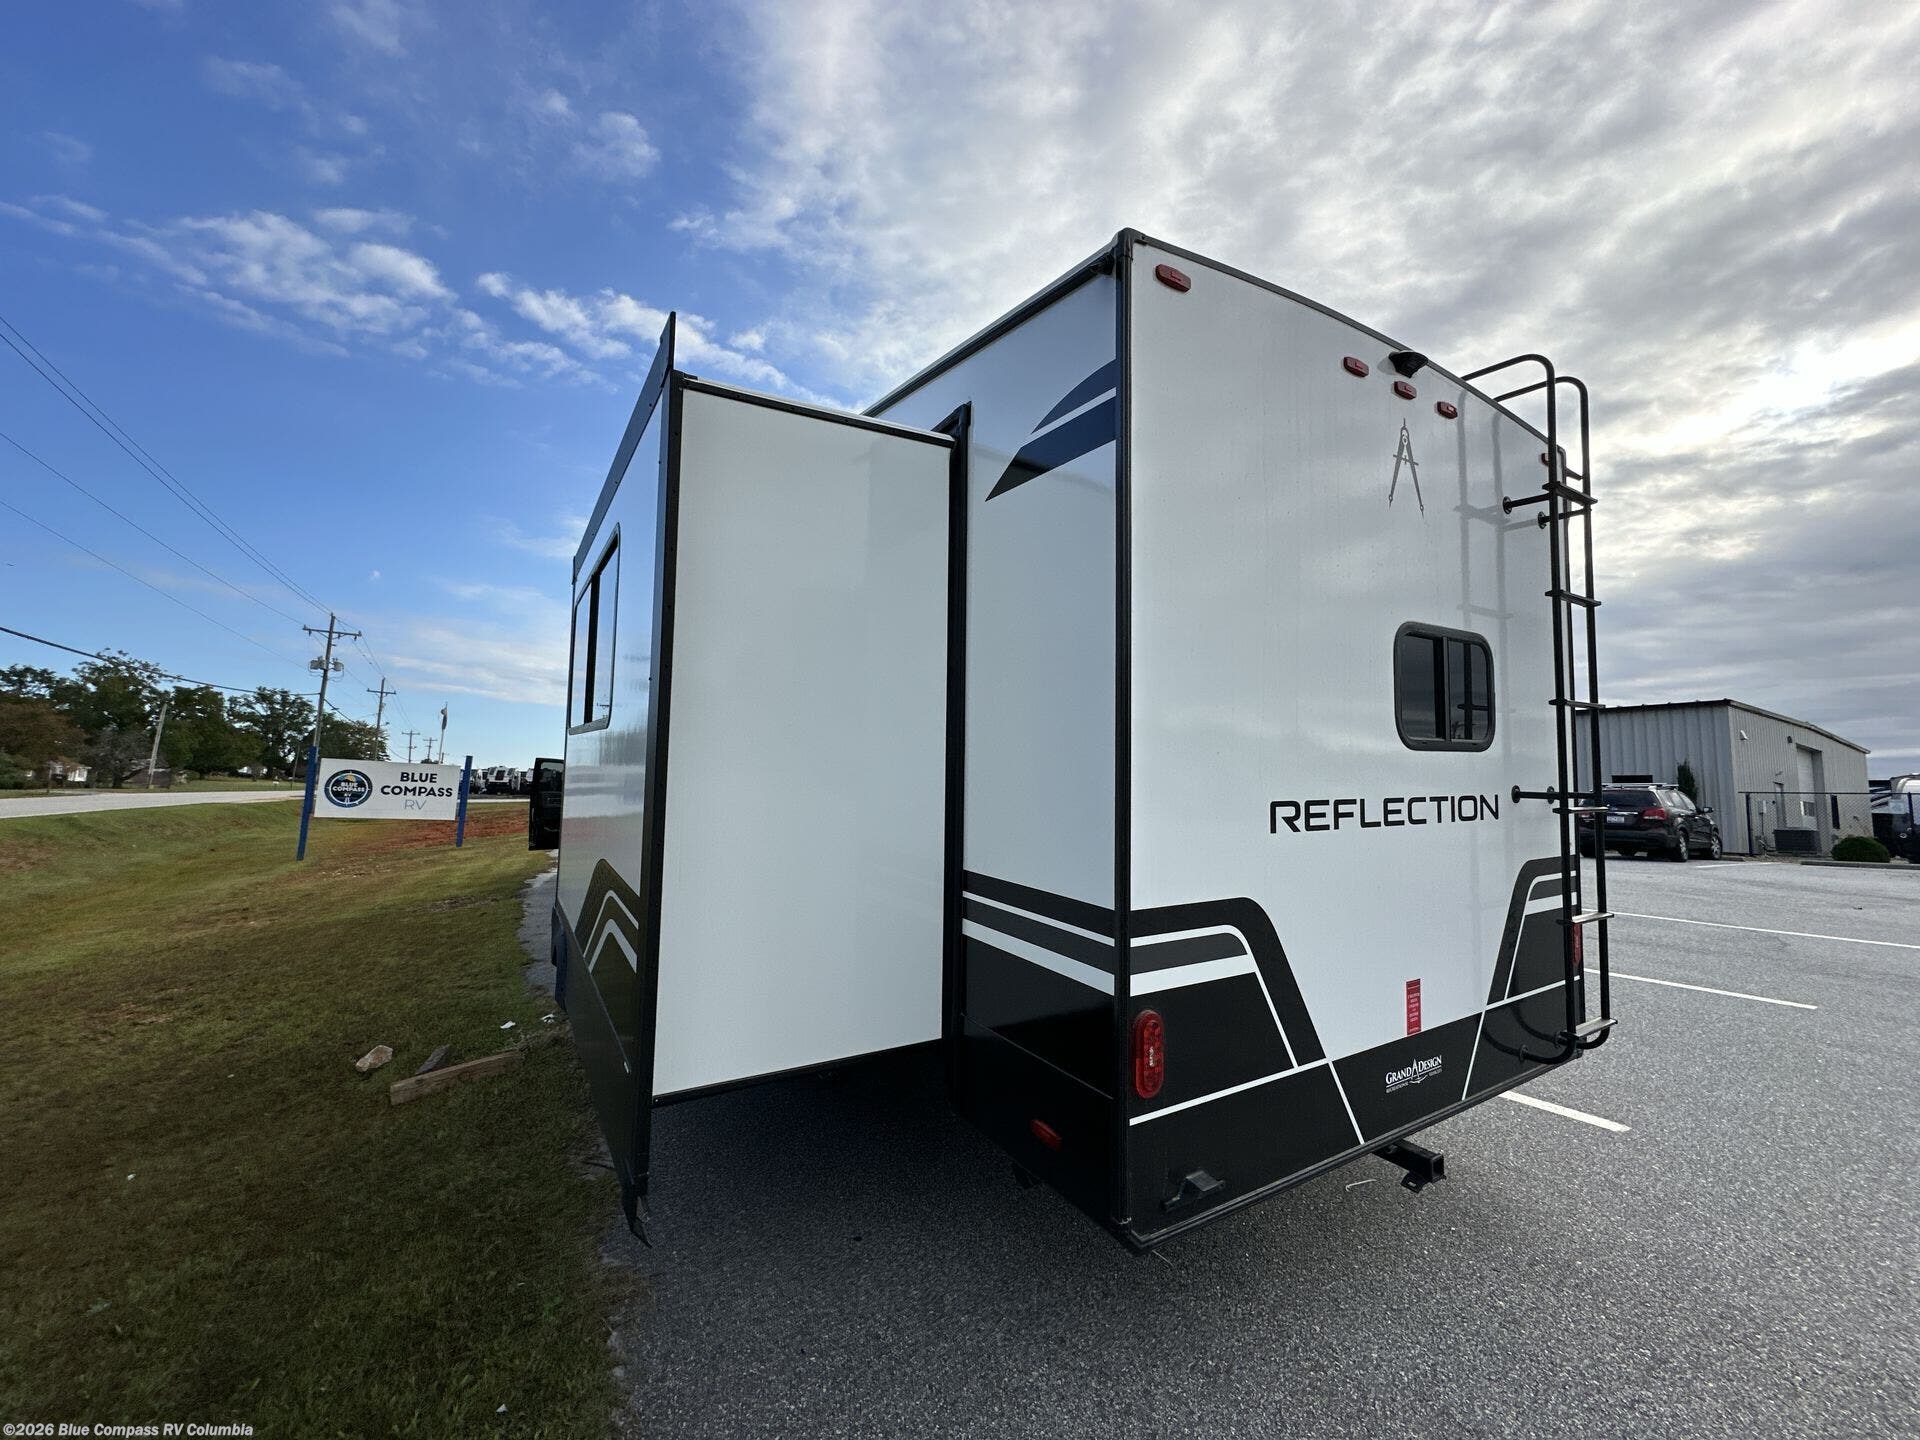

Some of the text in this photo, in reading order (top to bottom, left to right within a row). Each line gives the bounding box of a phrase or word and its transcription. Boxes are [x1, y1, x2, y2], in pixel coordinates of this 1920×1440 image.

[400, 772, 437, 783] BLUE
[380, 785, 453, 797] COMPASS
[404, 799, 426, 810] RV
[1269, 794, 1499, 834] REFLECTION
[1385, 1066, 1412, 1085] GRAND
[1418, 1055, 1442, 1072] DESIGN
